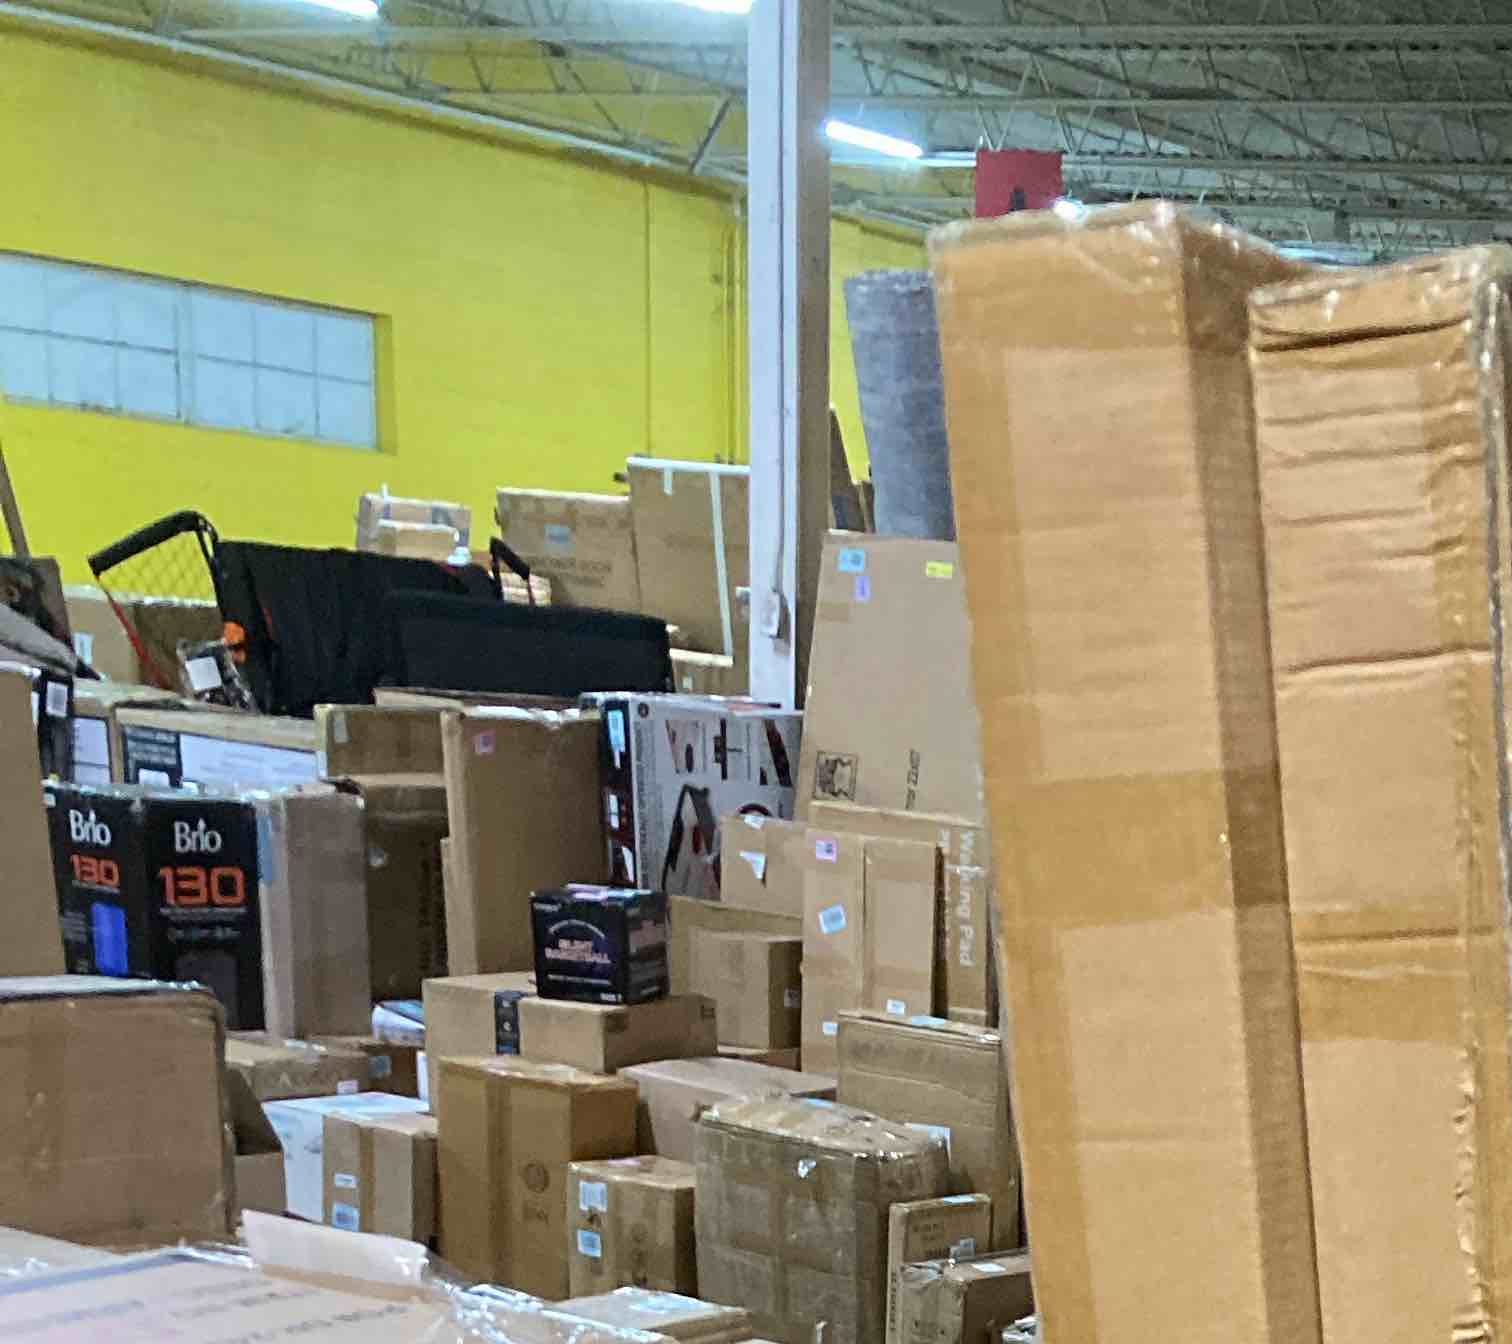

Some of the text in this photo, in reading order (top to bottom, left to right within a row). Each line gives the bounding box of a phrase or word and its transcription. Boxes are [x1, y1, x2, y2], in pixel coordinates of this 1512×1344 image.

[69, 809, 112, 846] Brio
[173, 818, 222, 854] Brio
[70, 854, 120, 887] 130
[160, 865, 247, 908] 130
